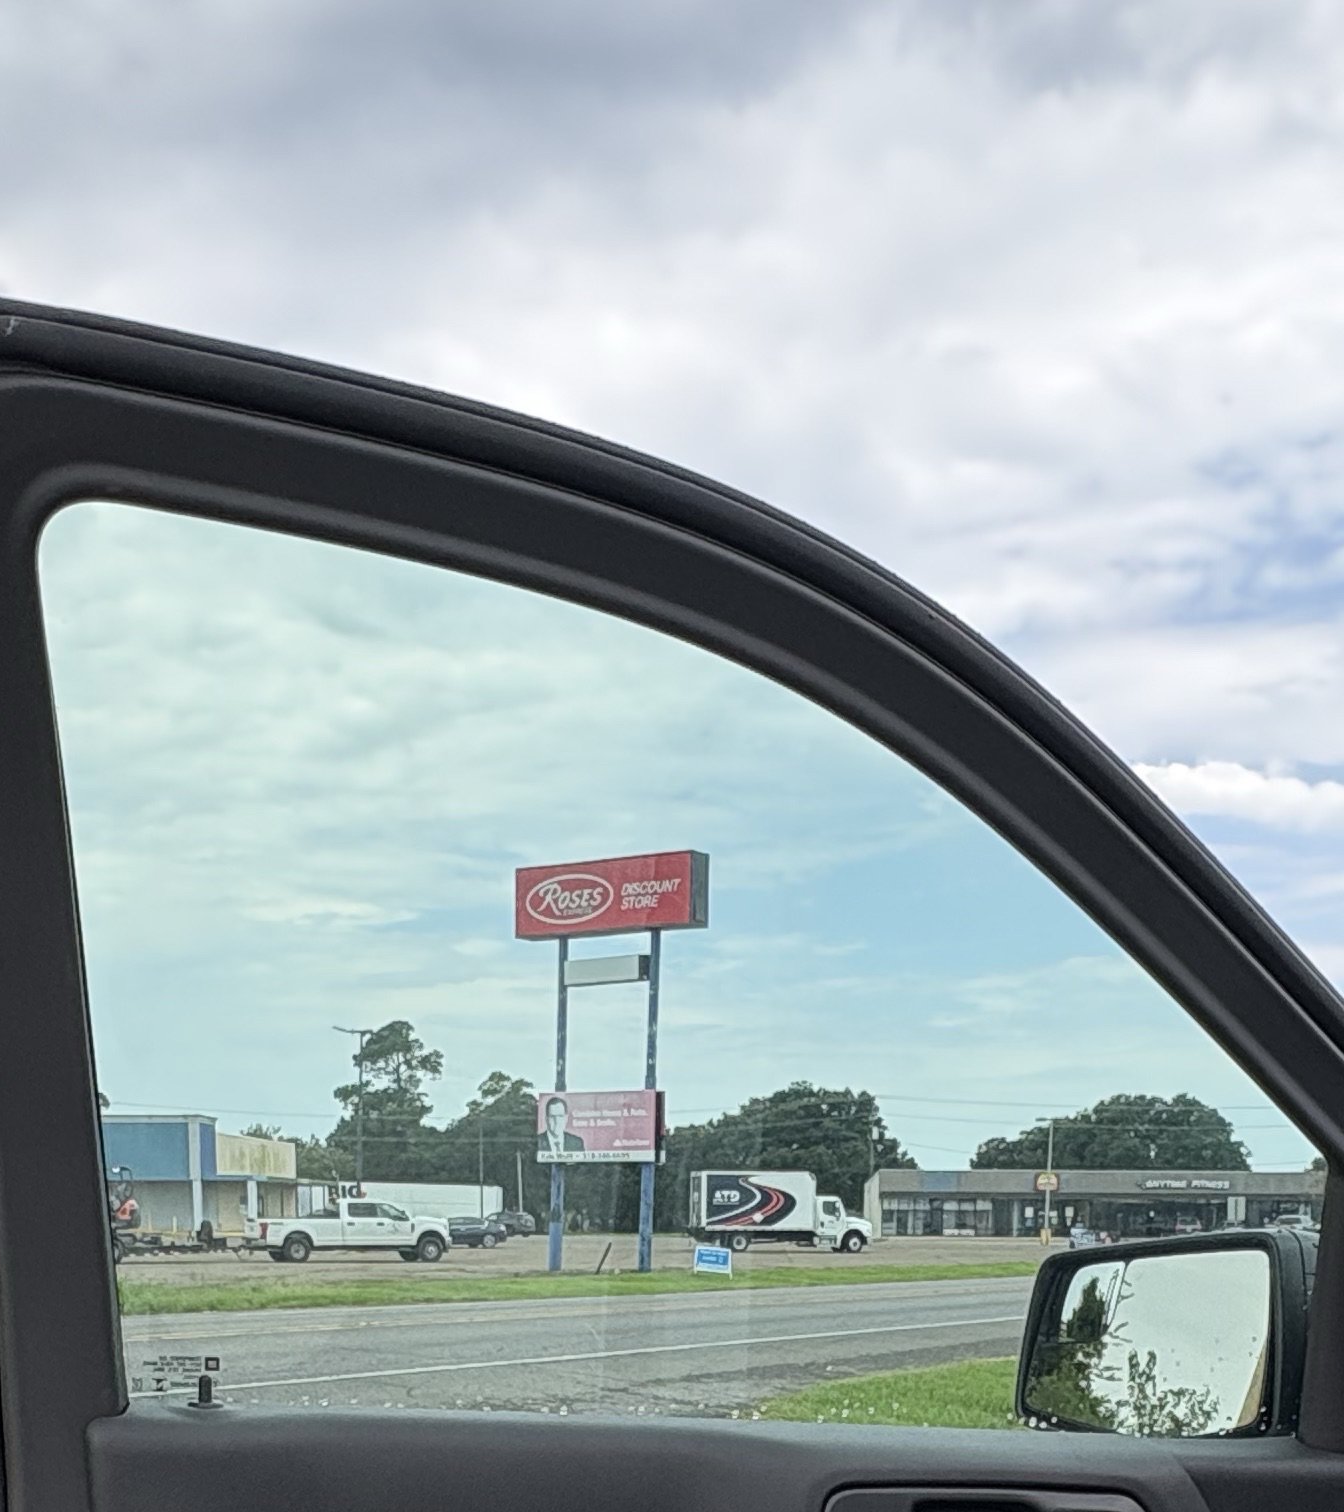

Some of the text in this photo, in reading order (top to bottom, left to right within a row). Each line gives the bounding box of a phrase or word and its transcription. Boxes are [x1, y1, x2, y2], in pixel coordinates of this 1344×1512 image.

[620, 879, 682, 896] DISCOUNT
[537, 883, 604, 915] ROSES
[620, 895, 660, 910] STORE
[1145, 1179, 1230, 1190] ANYTIME FITNESS
[713, 1190, 740, 1203] ATD
